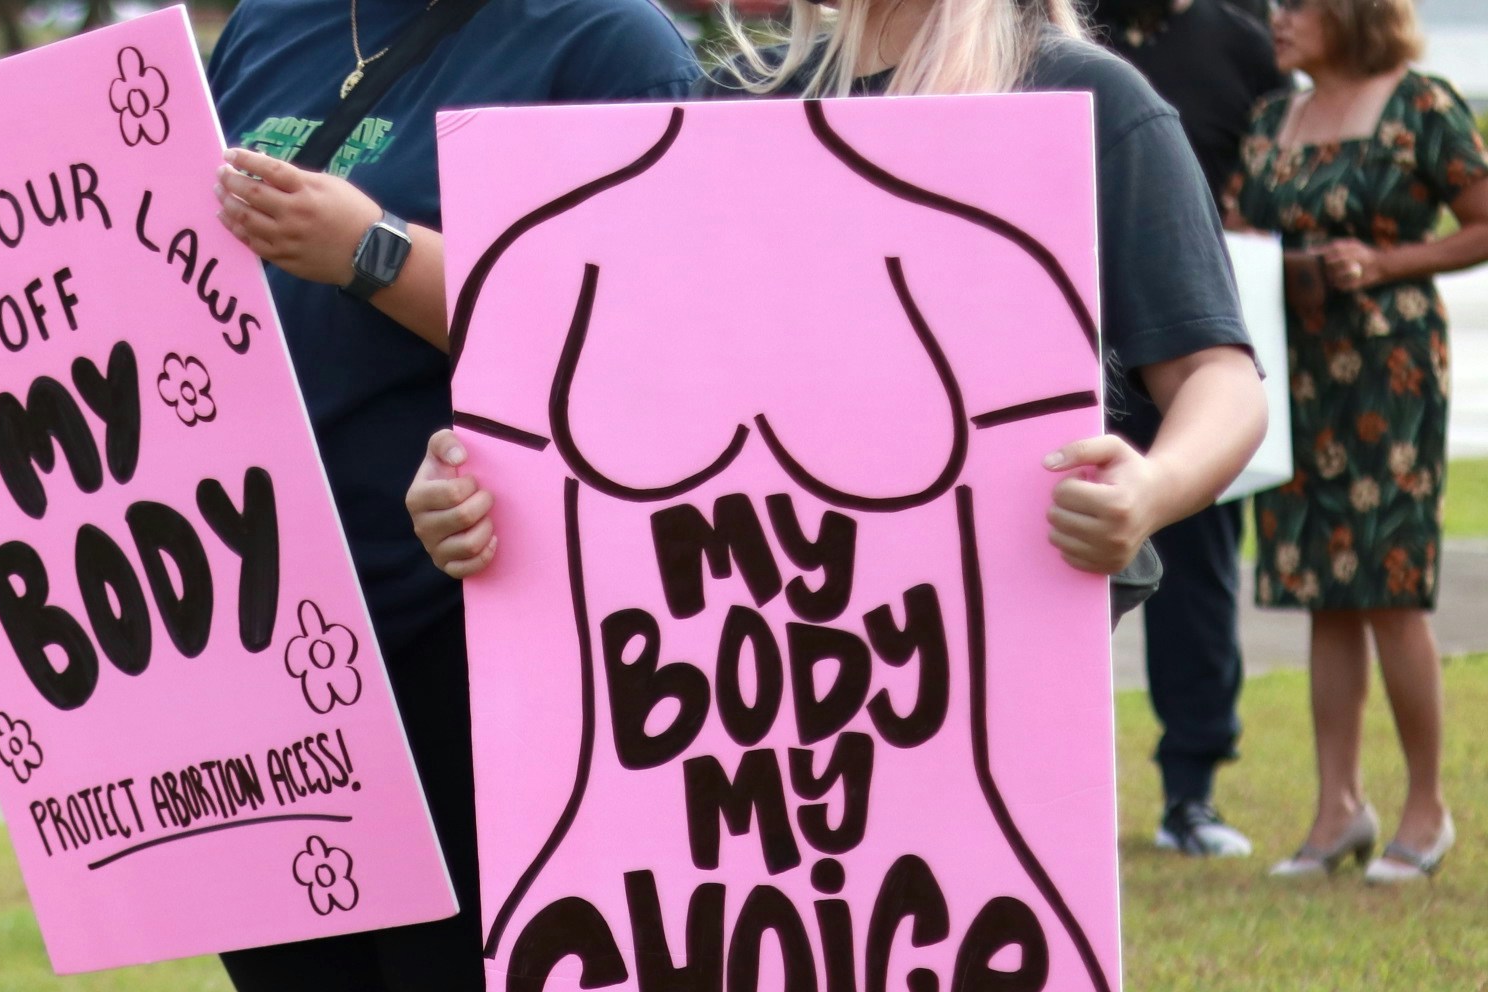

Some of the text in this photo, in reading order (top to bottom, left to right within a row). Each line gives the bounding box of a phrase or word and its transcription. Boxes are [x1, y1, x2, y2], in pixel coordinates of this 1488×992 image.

[136, 190, 261, 355] LAWS
[29, 729, 362, 857] PROTECT ABORTION ACESS!
